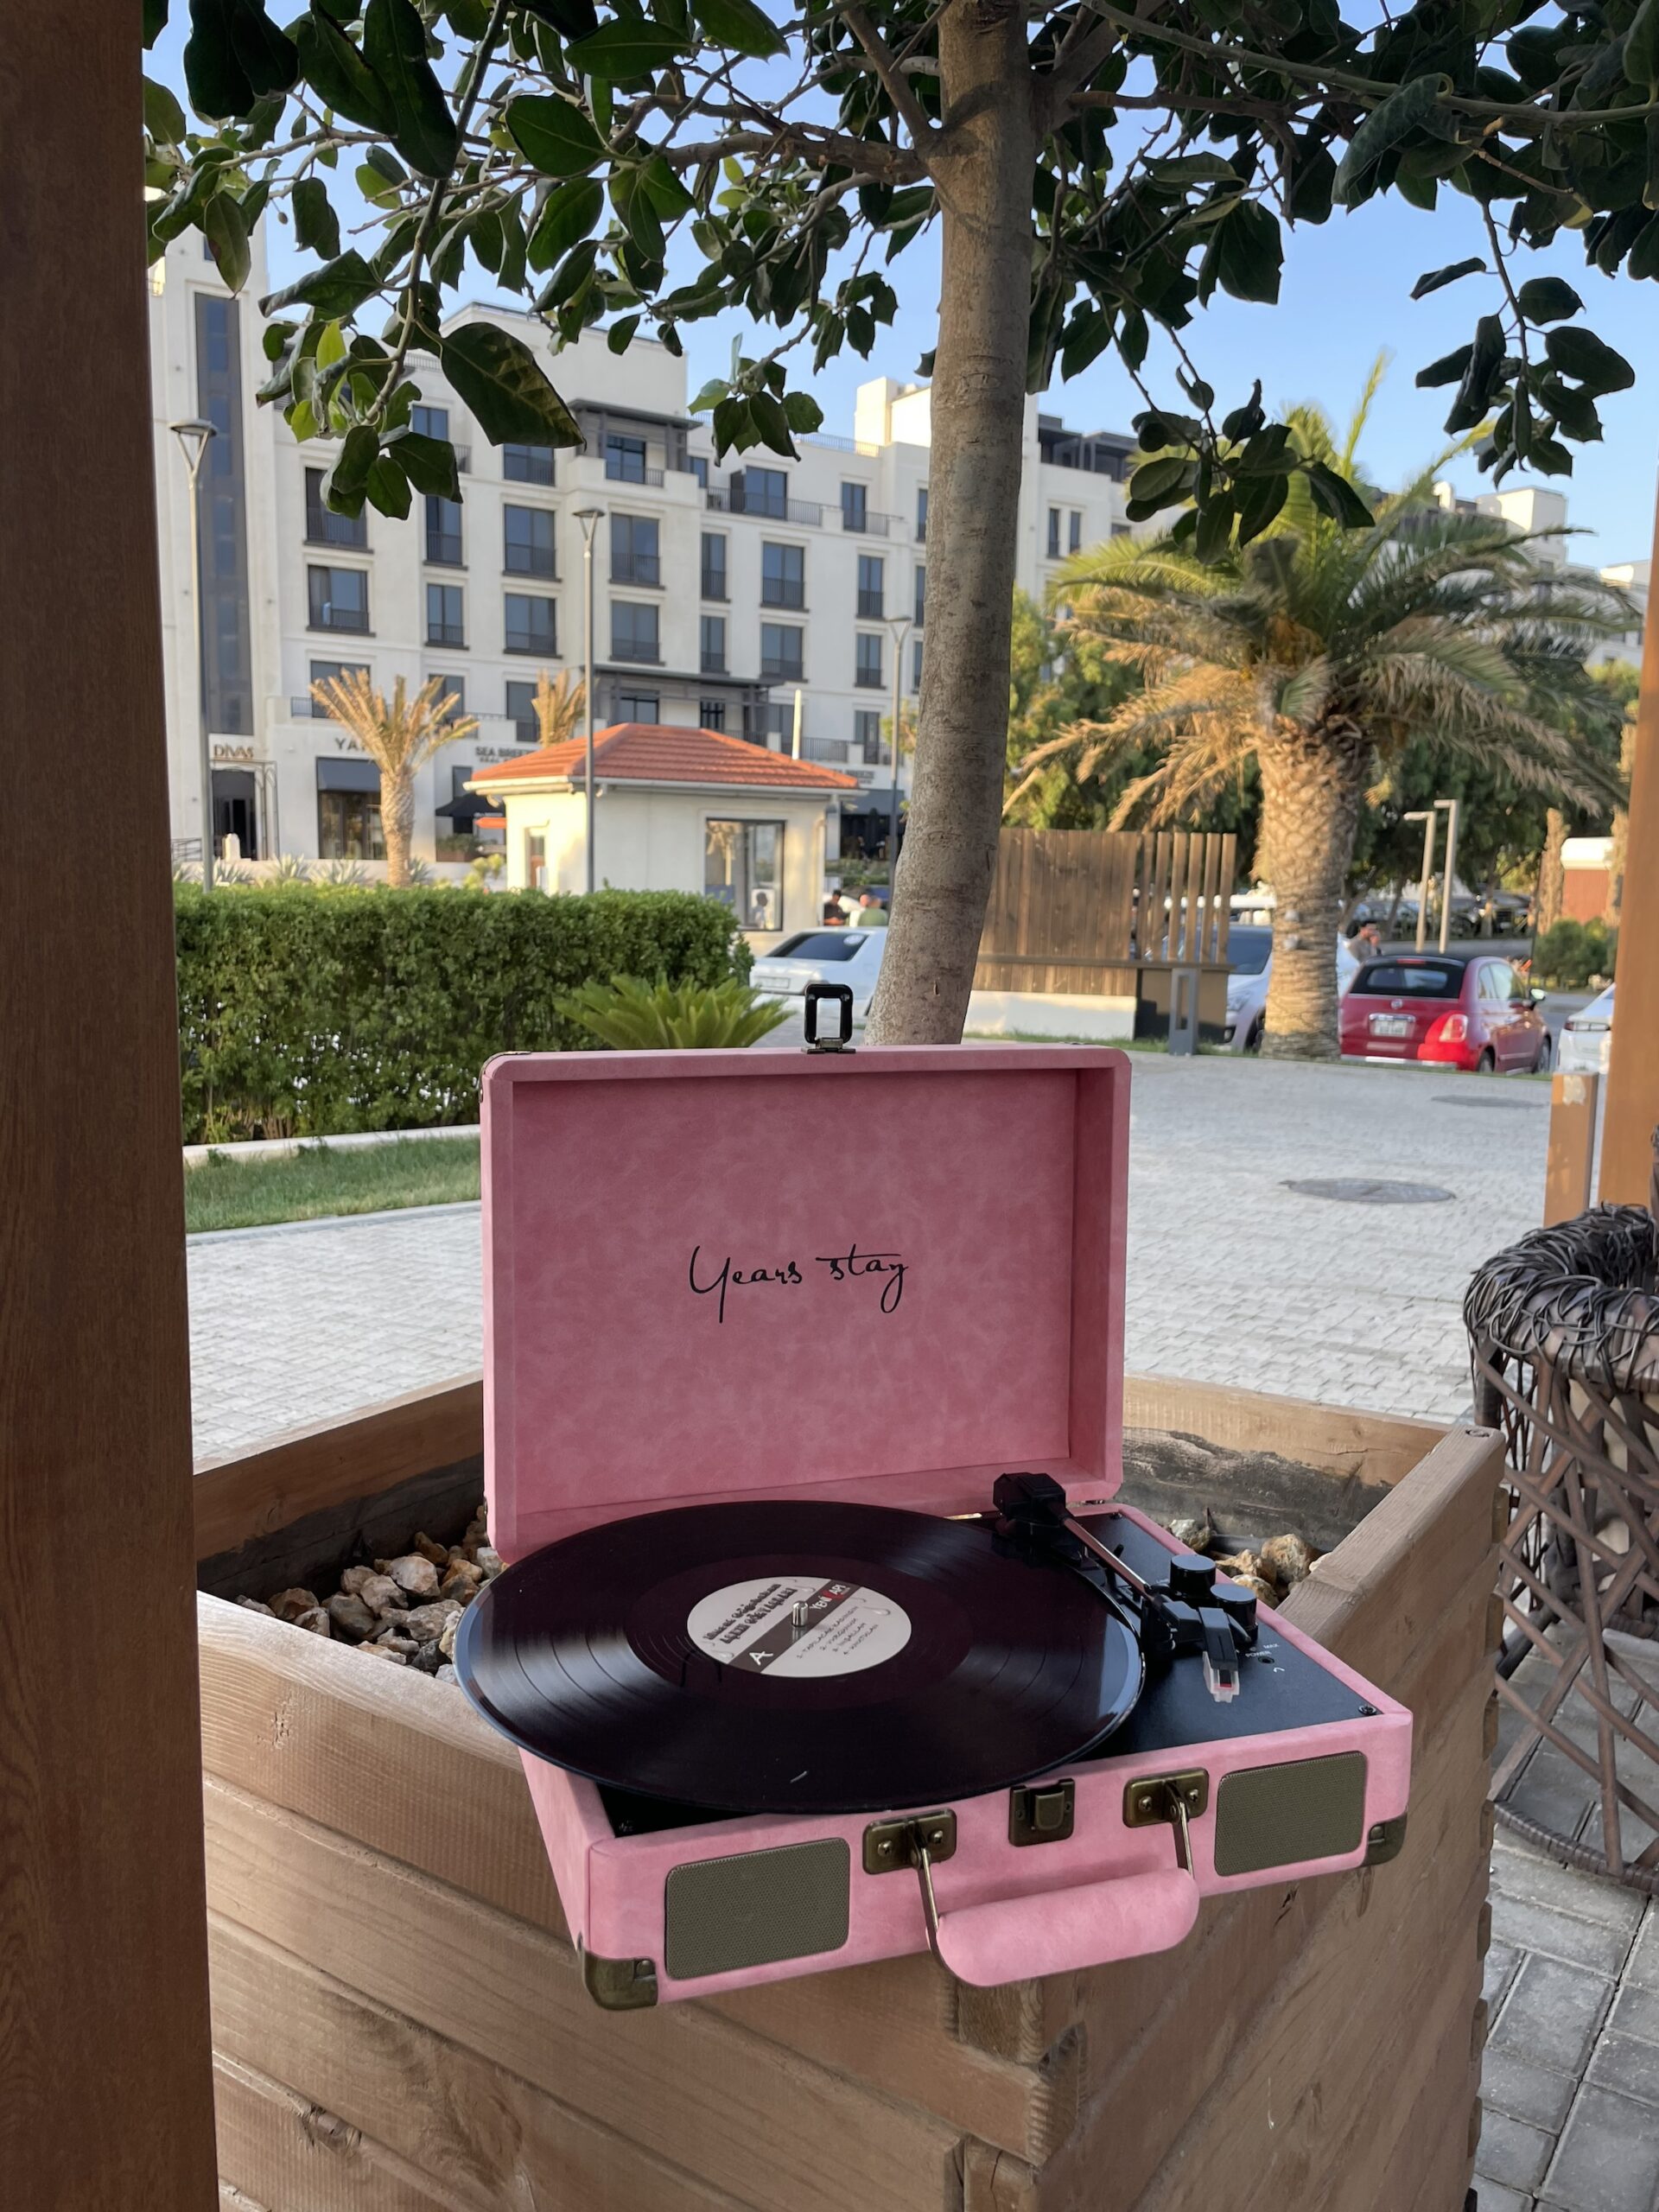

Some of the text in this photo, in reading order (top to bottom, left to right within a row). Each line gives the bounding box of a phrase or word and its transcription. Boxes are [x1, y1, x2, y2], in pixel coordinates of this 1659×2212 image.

[690, 1243, 909, 1324] Years stay
[749, 1651, 774, 1666] A
